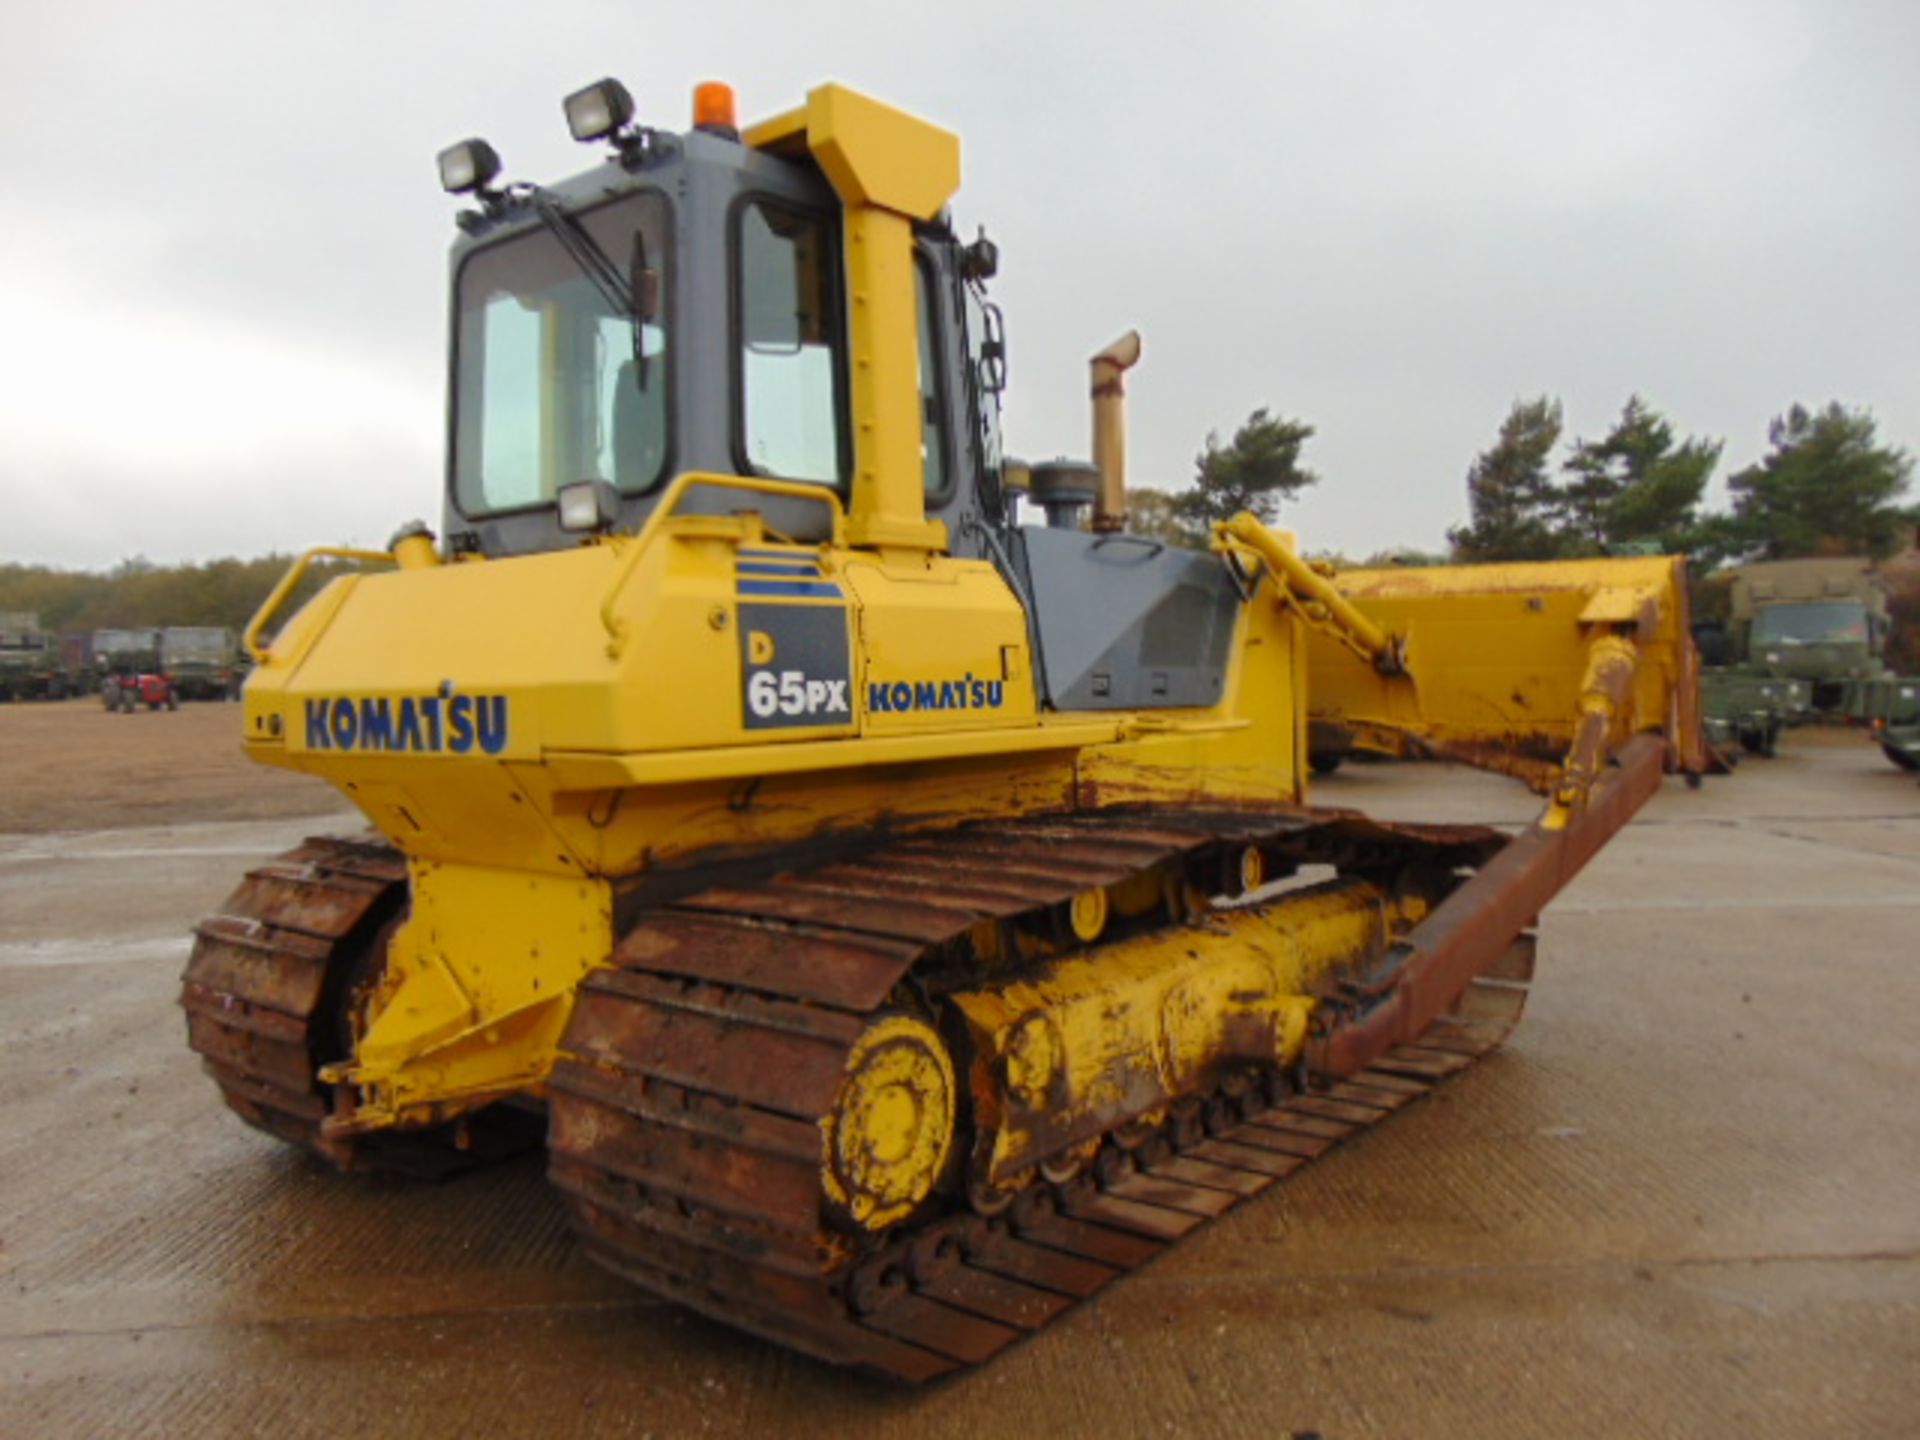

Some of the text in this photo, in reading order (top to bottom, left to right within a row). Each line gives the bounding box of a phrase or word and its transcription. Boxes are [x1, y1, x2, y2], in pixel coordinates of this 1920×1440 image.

[748, 630, 774, 665] D
[748, 670, 849, 717] 65PX
[869, 672, 1003, 712] KOMATSU
[305, 684, 508, 754] KOMATSU
